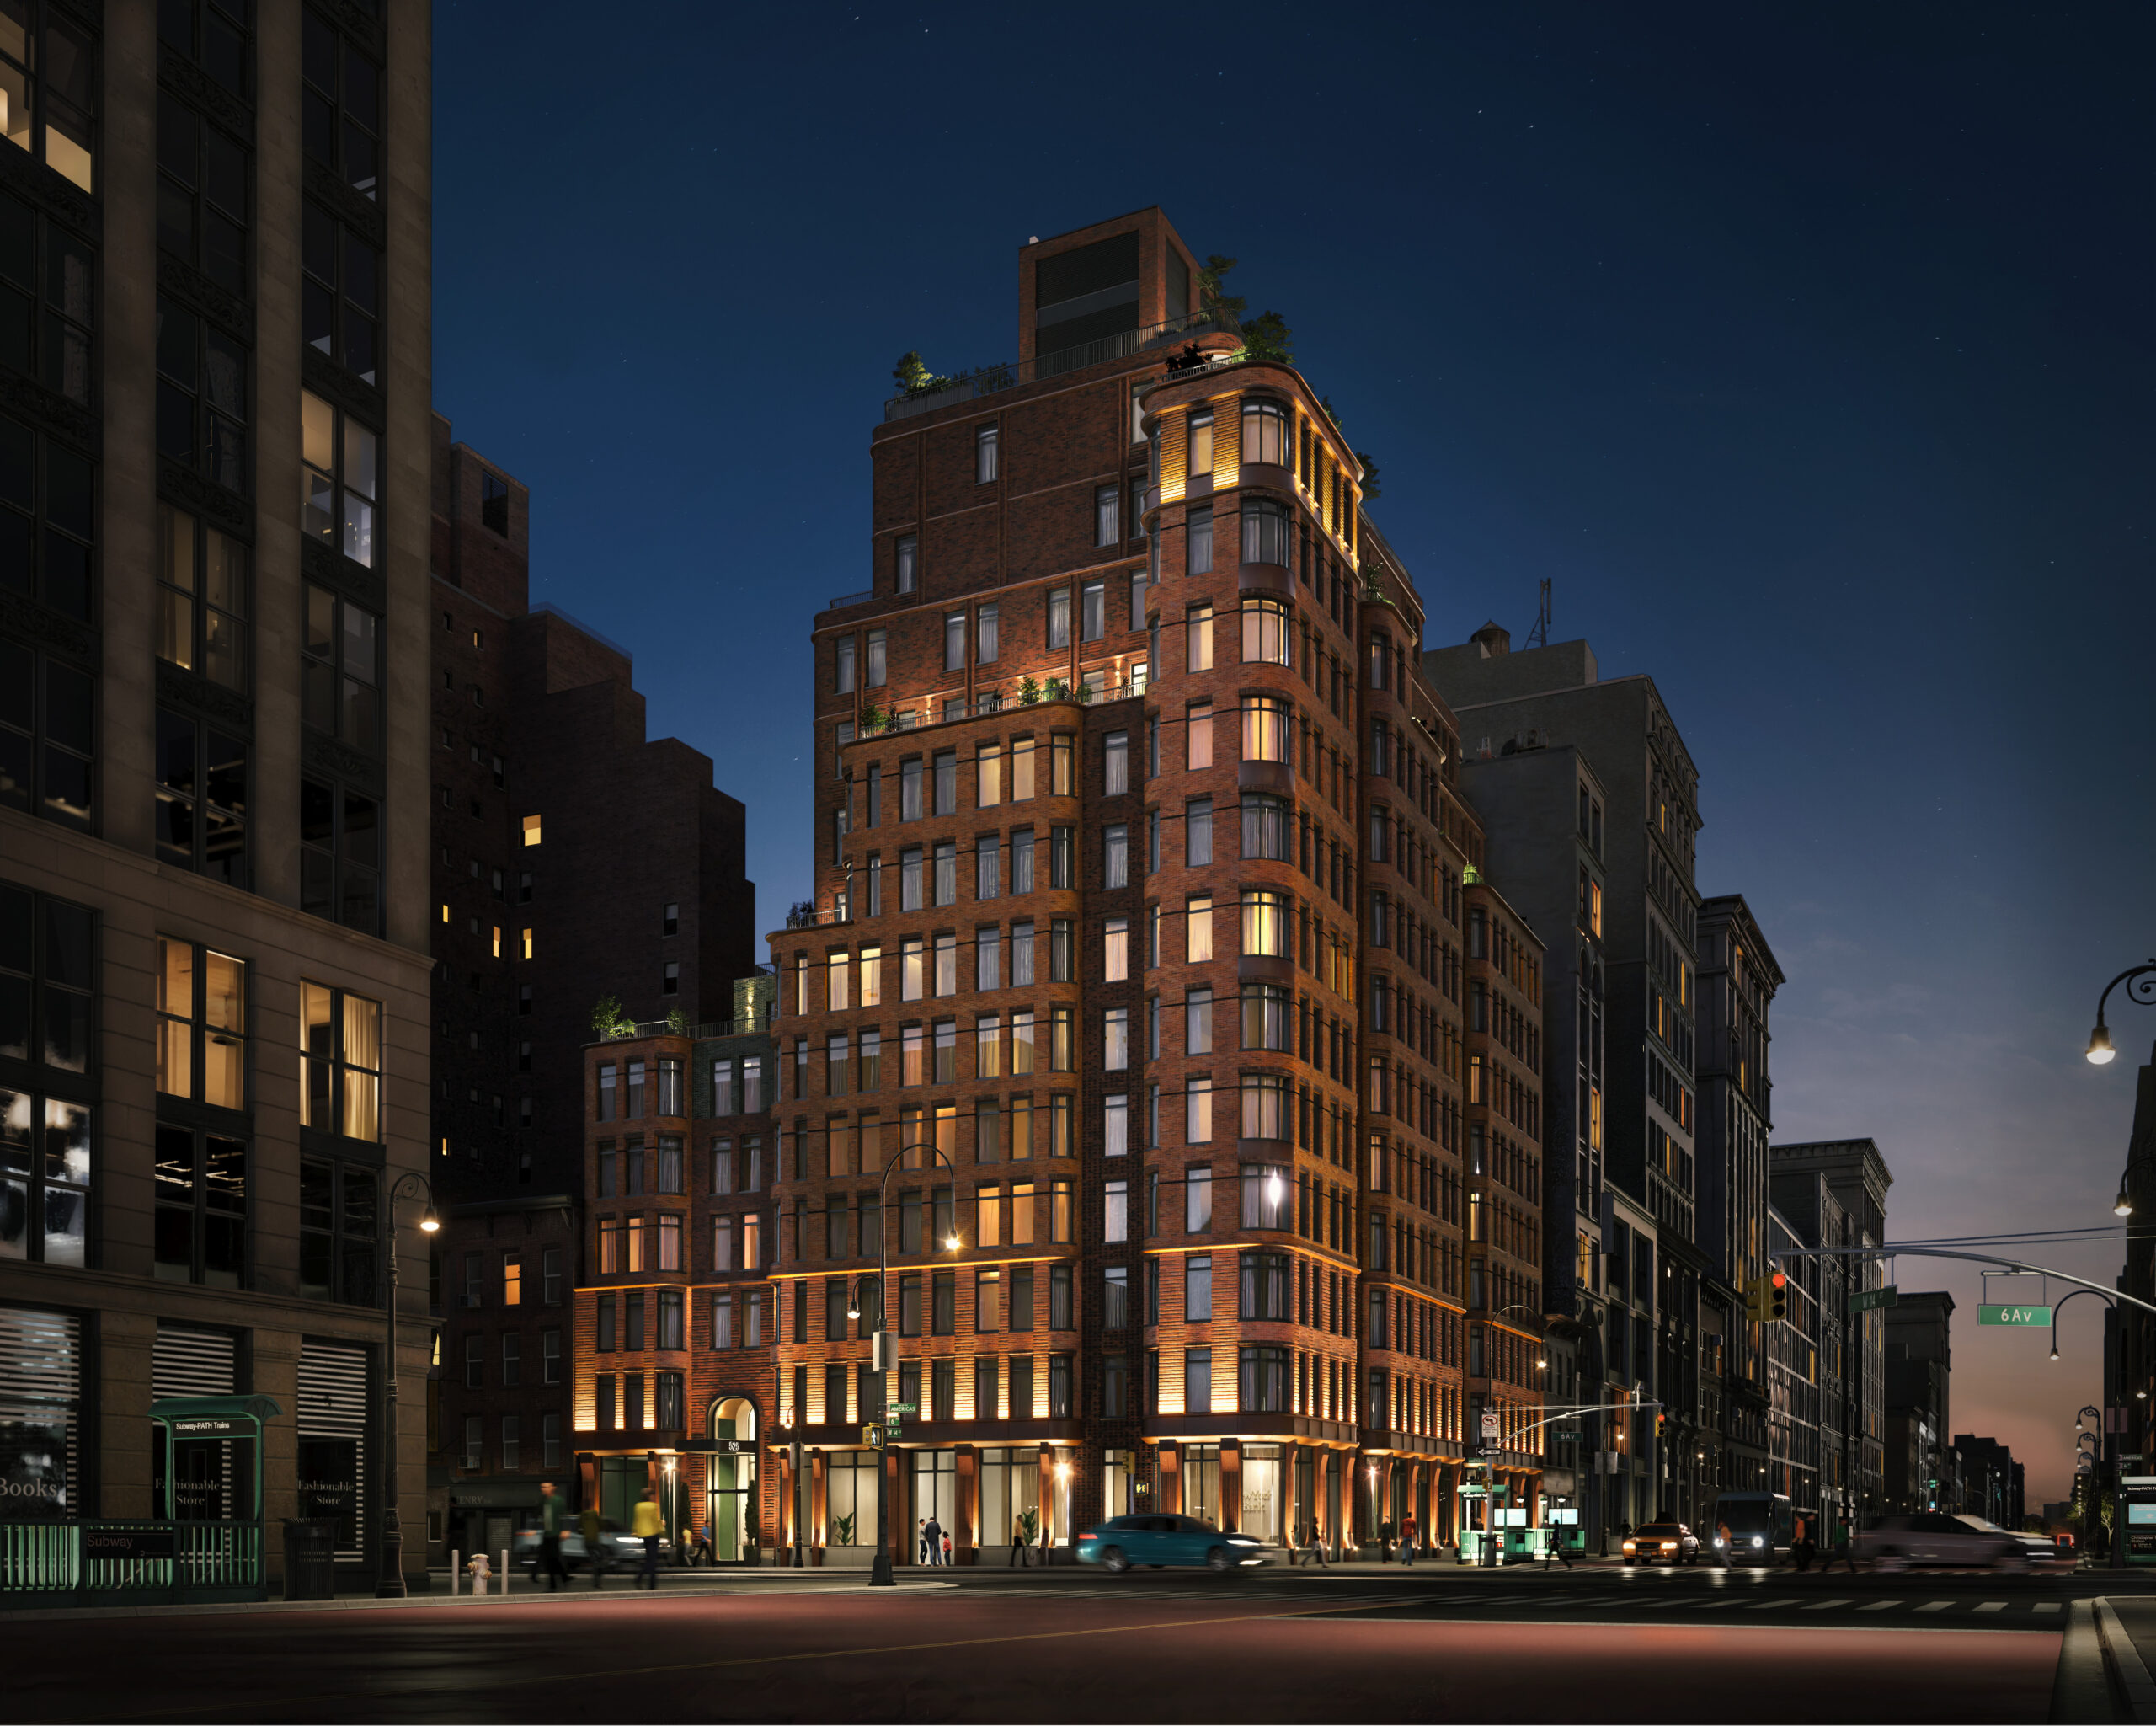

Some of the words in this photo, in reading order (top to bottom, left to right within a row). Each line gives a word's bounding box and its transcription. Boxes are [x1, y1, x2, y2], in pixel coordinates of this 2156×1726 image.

[175, 1422, 212, 1431] Subway-PATH
[0, 1477, 57, 1497] Books
[298, 1478, 354, 1492] Fashionable
[175, 1494, 206, 1505] Store
[316, 1494, 342, 1506] Store
[87, 1535, 133, 1550] Subway
